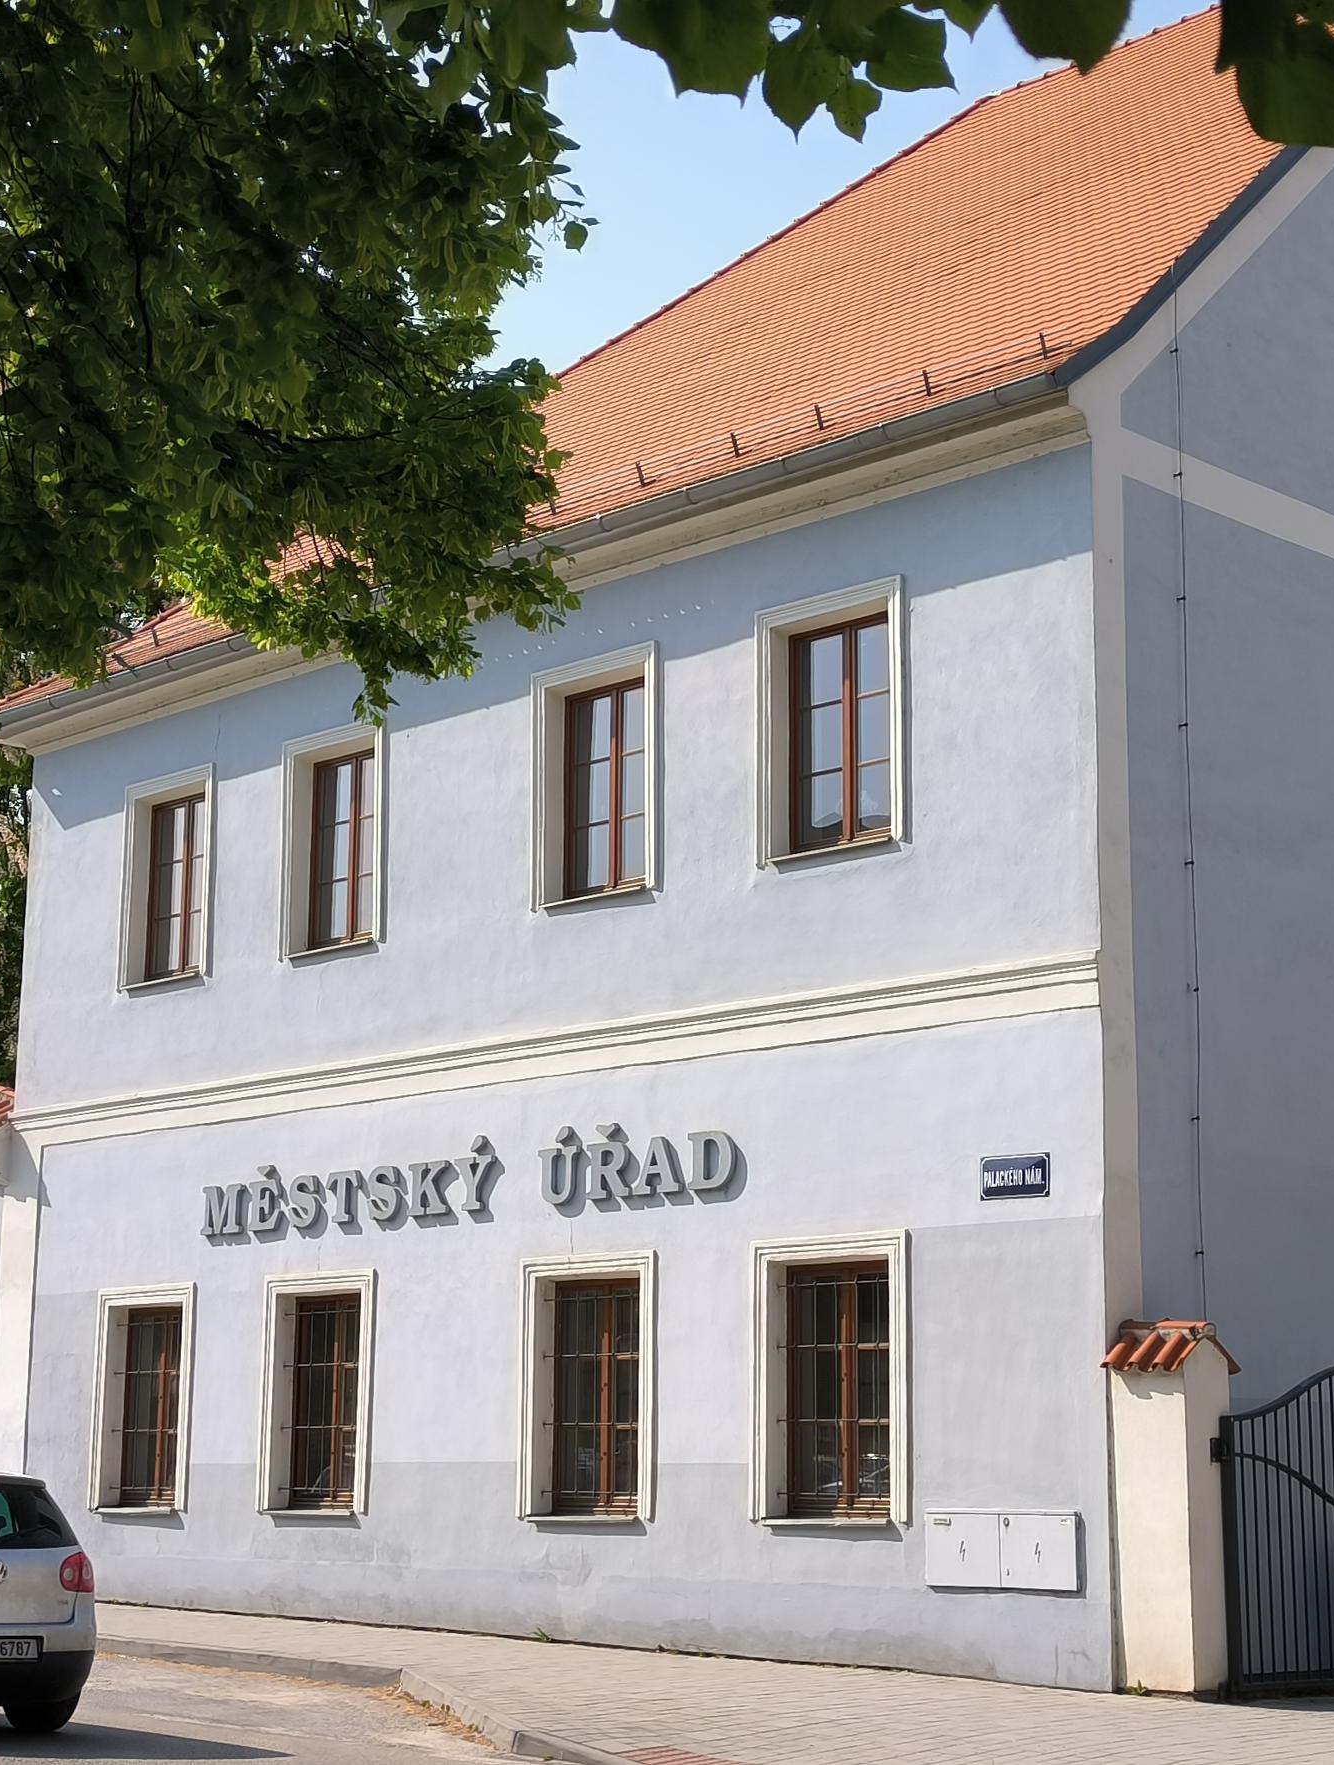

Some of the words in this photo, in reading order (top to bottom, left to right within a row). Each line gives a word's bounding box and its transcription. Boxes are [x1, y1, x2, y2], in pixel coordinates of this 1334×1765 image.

[200, 1136, 501, 1241] MĚSTSKÝ
[538, 1123, 742, 1209] ÚŘAD
[984, 1167, 1023, 1189] PALACKÉHO
[1025, 1166, 1045, 1185] NÁM.
[0, 1641, 31, 1657] 6787
